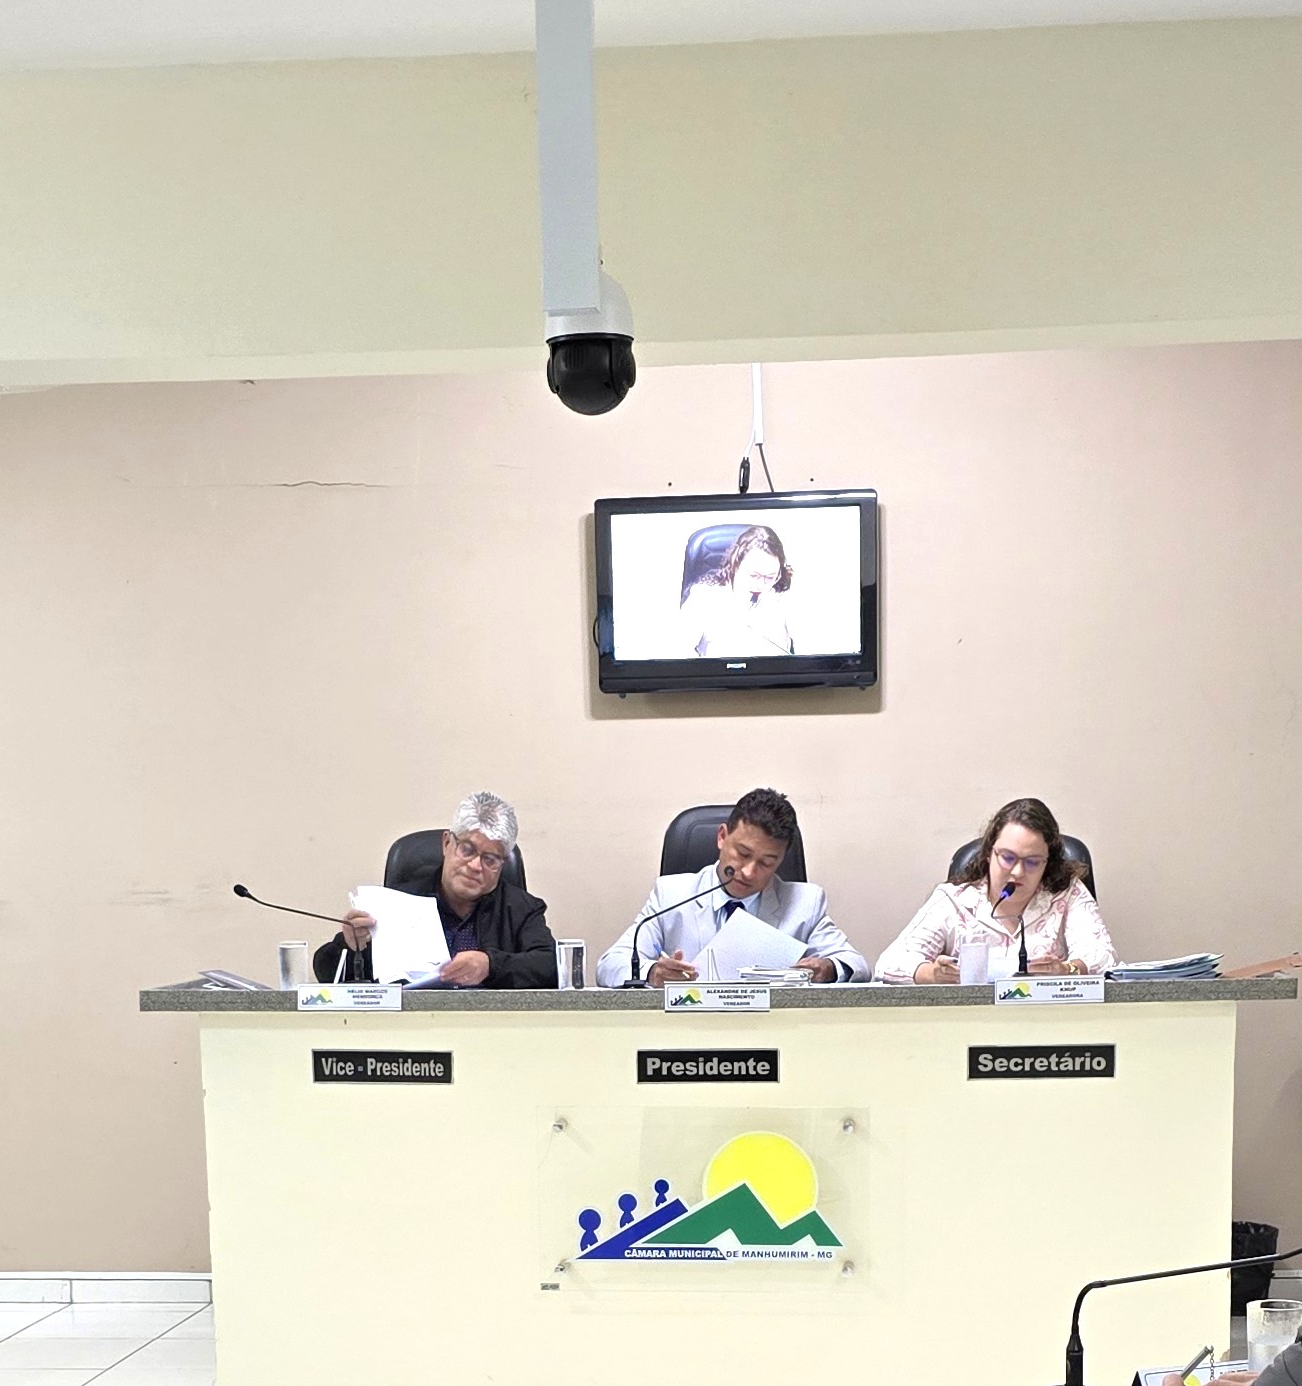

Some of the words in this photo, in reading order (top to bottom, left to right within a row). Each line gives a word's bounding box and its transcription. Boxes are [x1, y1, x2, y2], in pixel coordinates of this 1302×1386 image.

[321, 1057, 355, 1076] Vice
[366, 1058, 445, 1077] Presidente
[646, 1057, 771, 1076] Presidente
[977, 1052, 1107, 1072] Secretário
[624, 1247, 667, 1259] CÂMARA
[668, 1249, 724, 1259] MUNICIPAL
[726, 1250, 740, 1259] DE
[741, 1250, 809, 1259] MANHUMIRIM
[817, 1250, 833, 1259] MG
